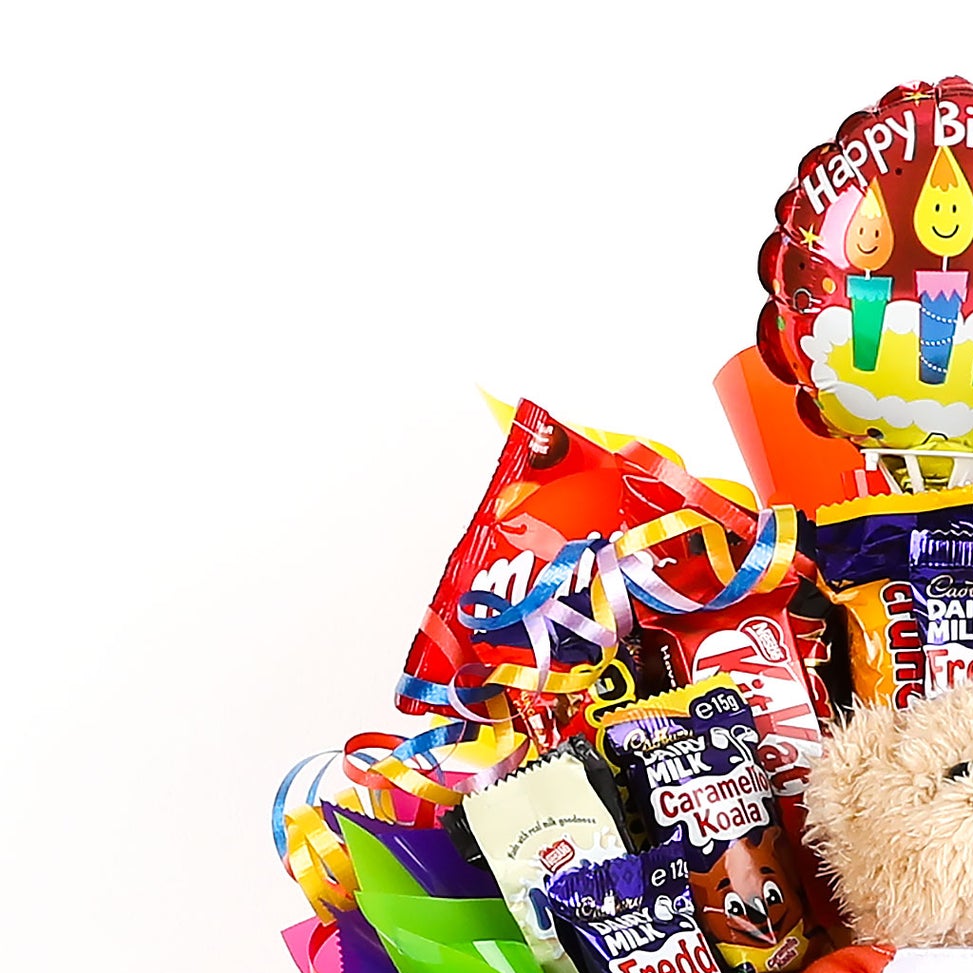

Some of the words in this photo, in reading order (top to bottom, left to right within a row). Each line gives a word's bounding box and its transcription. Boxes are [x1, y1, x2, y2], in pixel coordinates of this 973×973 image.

[803, 110, 917, 214] Happy
[711, 694, 740, 714] 15g
[634, 736, 706, 765] DAIRY
[646, 753, 712, 789] MILK
[659, 764, 769, 818] Caramello
[693, 798, 762, 838] Koala
[588, 907, 653, 936] DAIRY
[604, 924, 666, 957] MILK
